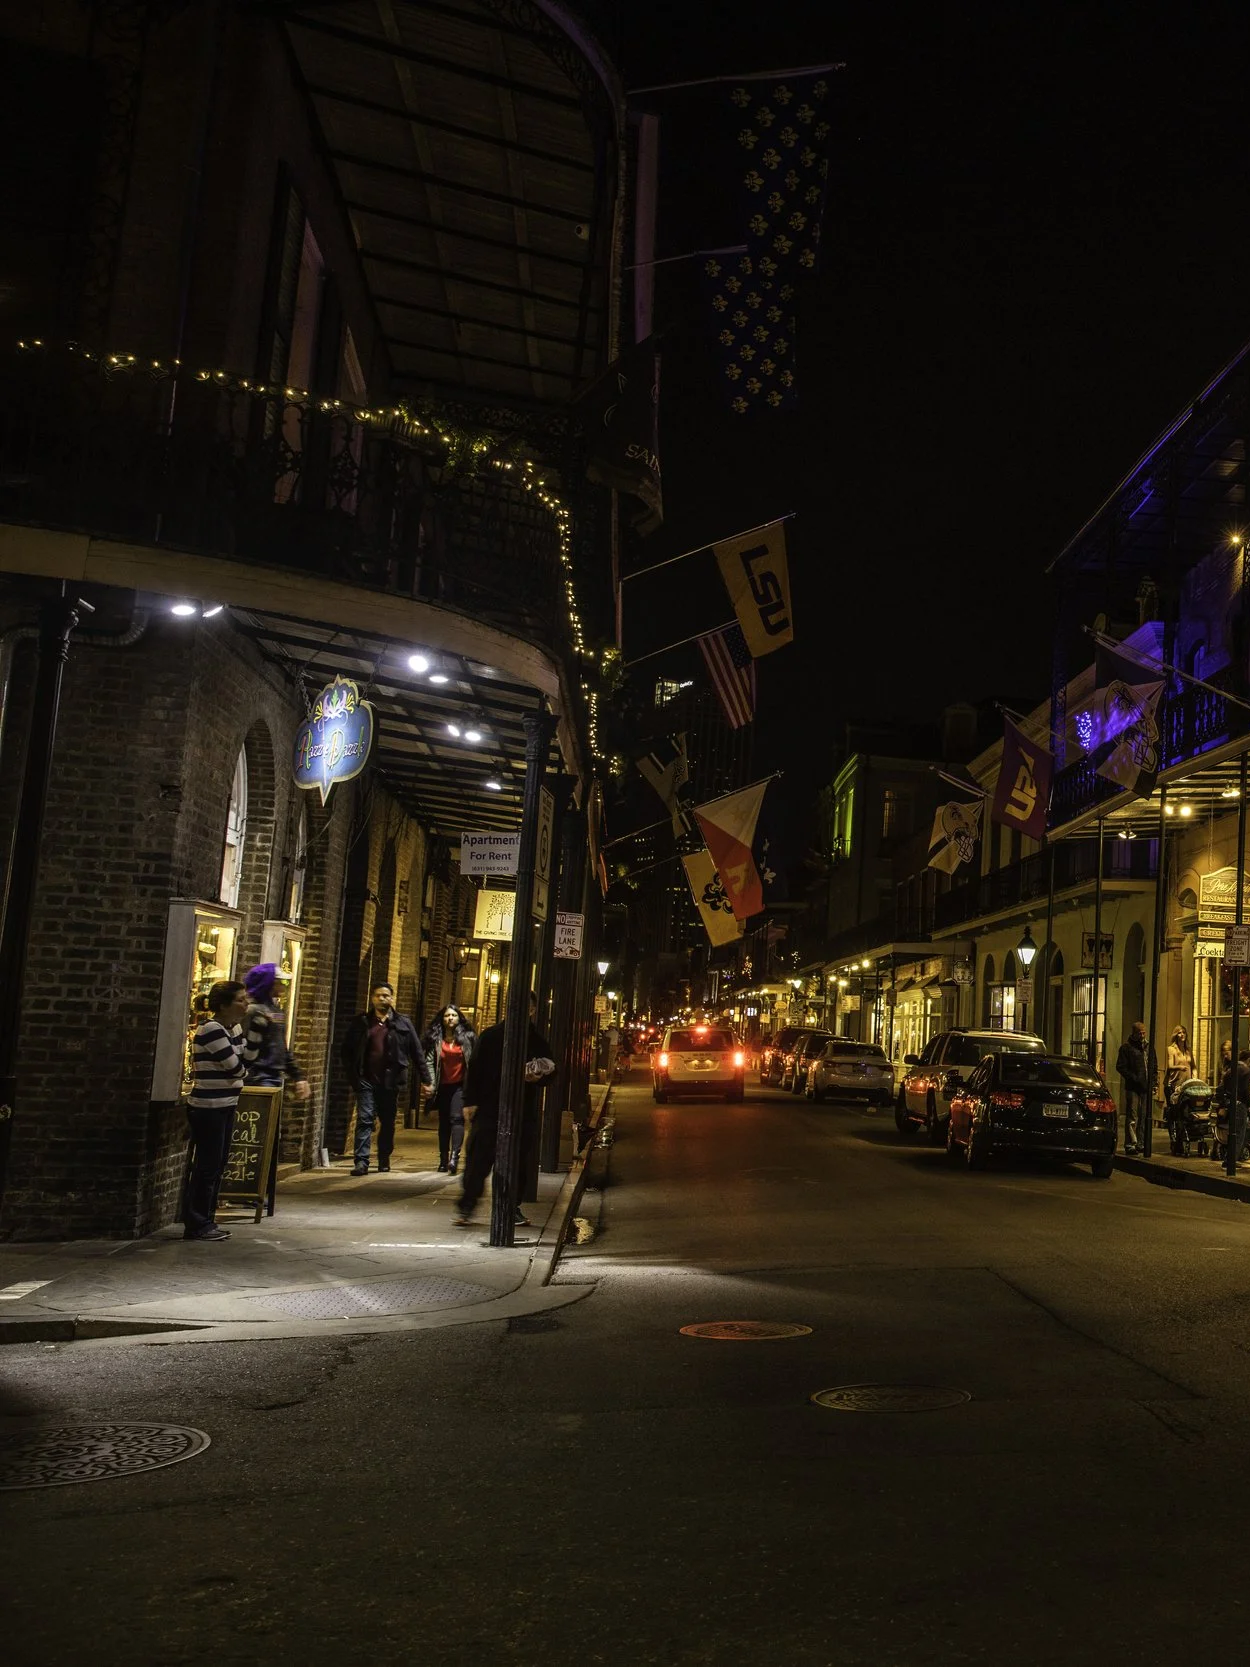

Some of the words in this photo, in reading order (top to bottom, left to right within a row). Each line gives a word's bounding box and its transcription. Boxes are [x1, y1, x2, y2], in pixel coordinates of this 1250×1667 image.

[739, 543, 791, 637] LSU
[462, 834, 520, 847] Apartment
[470, 851, 486, 860] For
[489, 851, 512, 860] Rent
[556, 914, 567, 924] NO
[560, 928, 576, 936] FIRE
[558, 938, 576, 946] LANE
[231, 1123, 260, 1144] cal
